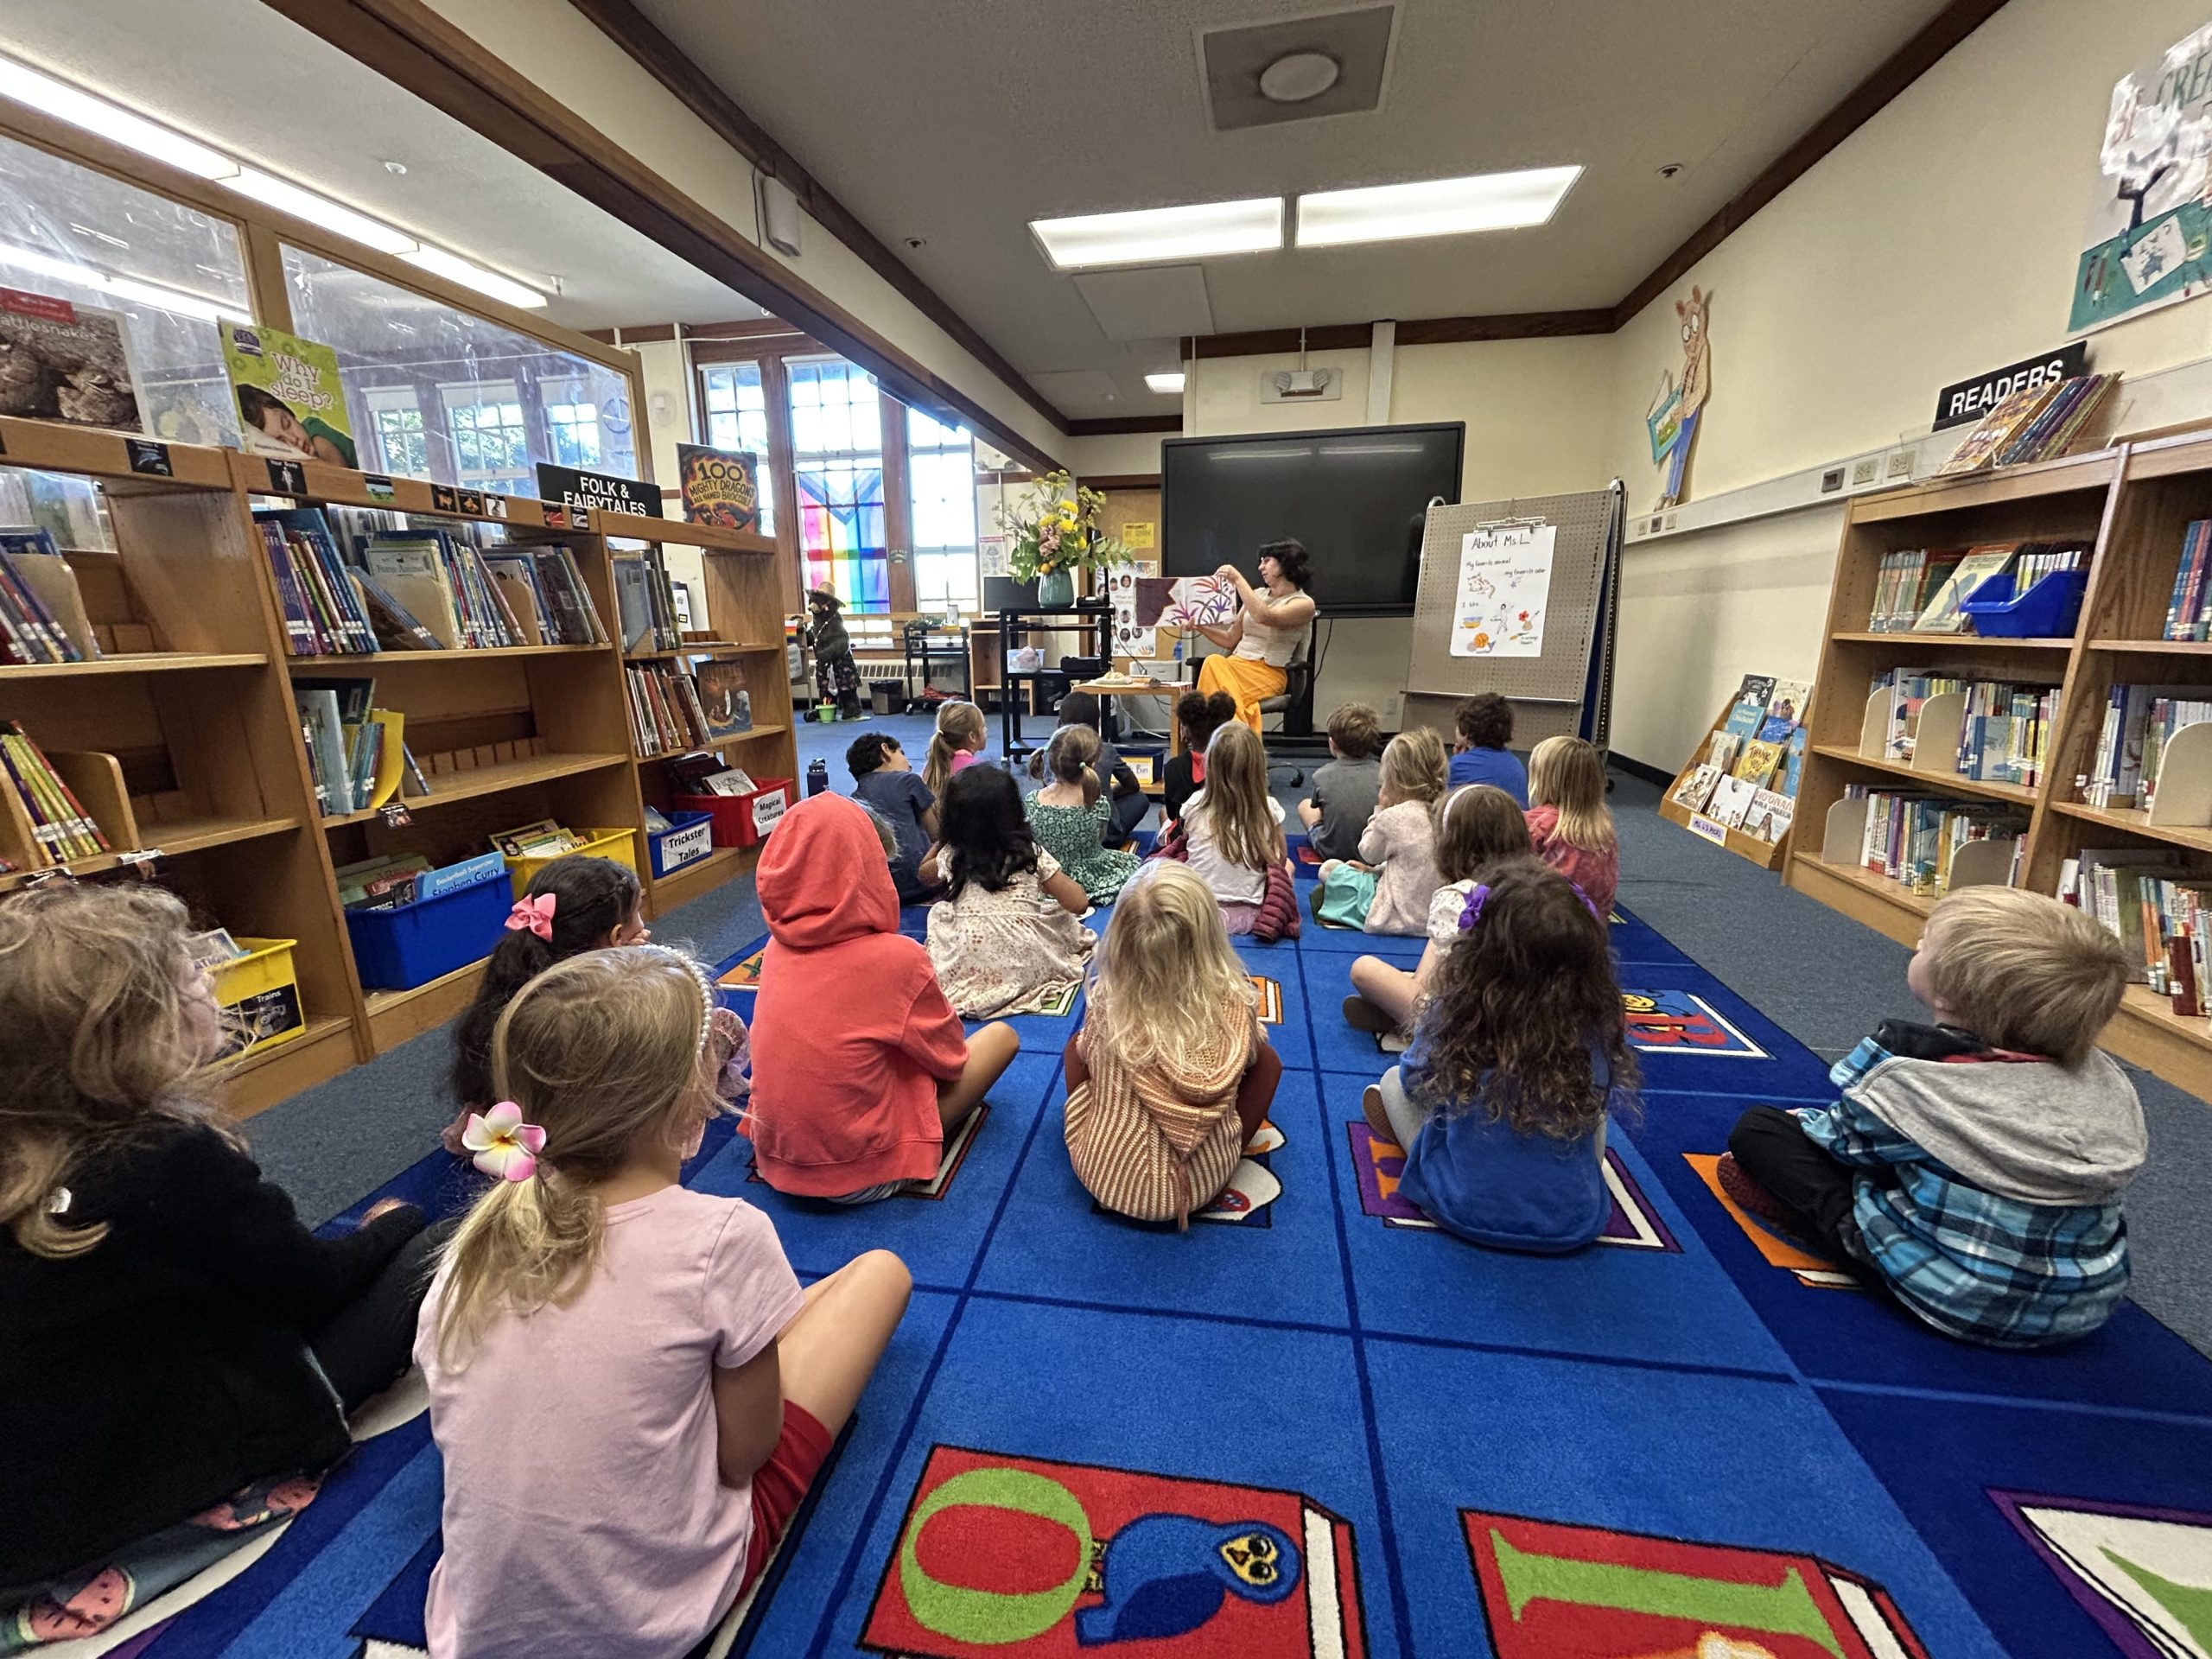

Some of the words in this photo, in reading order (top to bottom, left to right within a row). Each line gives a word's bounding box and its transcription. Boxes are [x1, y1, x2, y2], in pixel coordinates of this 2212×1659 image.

[0, 315, 98, 341] attlesnakes
[272, 353, 319, 382] Why
[283, 374, 302, 387] do
[1949, 359, 2063, 416] READERS
[270, 383, 332, 408] sleep?
[698, 462, 743, 482] 100
[580, 476, 618, 497] FOLK
[620, 484, 630, 499] &
[689, 480, 718, 497] MIGHTY
[720, 479, 755, 499] DRAGONS
[563, 491, 646, 517] FAIRYTALES
[1471, 533, 1497, 550] About
[1520, 533, 1530, 545] L
[1749, 746, 1771, 761] THANK
[760, 798, 781, 811] Magical
[758, 810, 785, 824] Creatures
[669, 827, 706, 849] Trickster
[678, 847, 700, 862] Tales
[432, 879, 473, 897] Stephen
[474, 867, 499, 882] Curry
[257, 991, 282, 1003] Trains
[900, 1467, 1093, 1644] O
